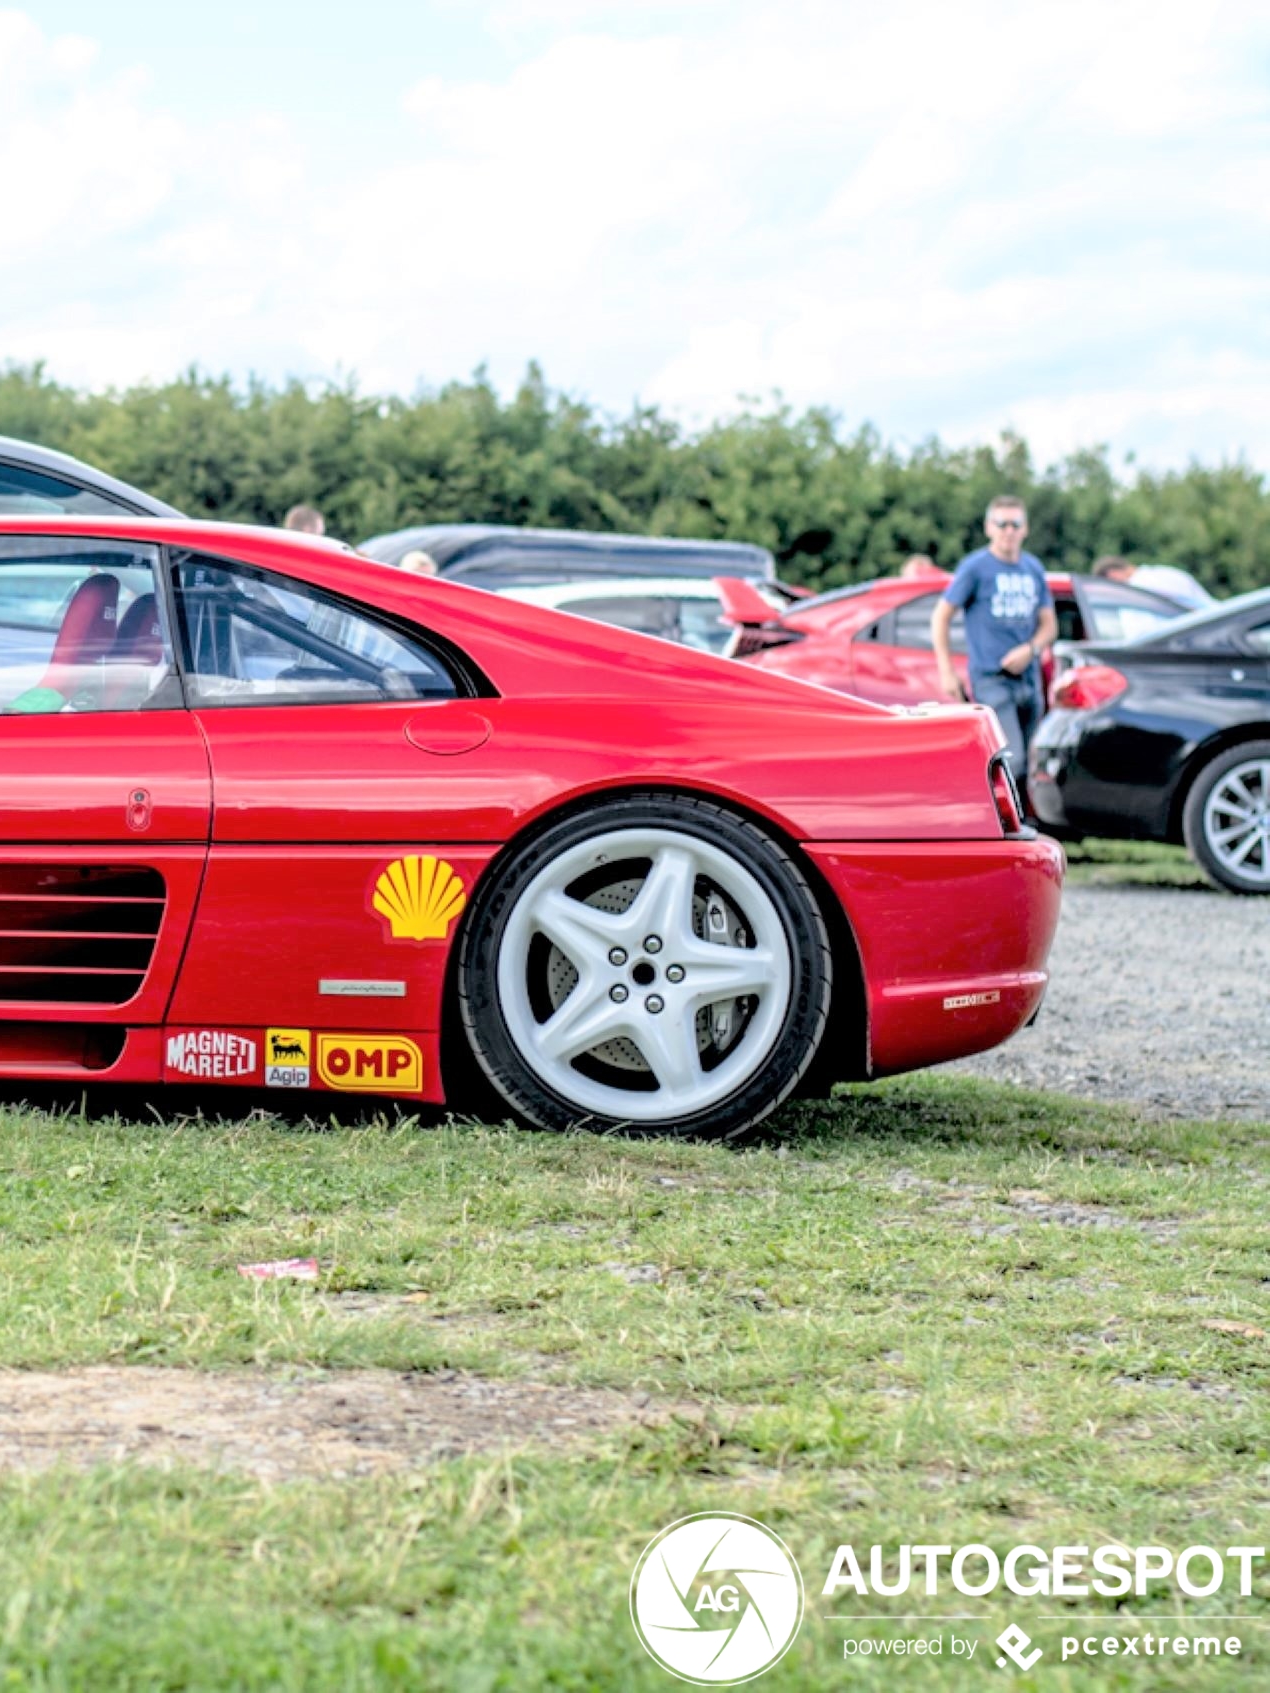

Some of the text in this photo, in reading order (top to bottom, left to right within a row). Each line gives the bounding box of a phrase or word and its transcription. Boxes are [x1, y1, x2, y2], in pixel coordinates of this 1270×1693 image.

[167, 1031, 256, 1060] MAGNETI
[167, 1048, 256, 1077] MARELLI
[269, 1067, 307, 1086] Agip
[326, 1047, 412, 1078] OMP
